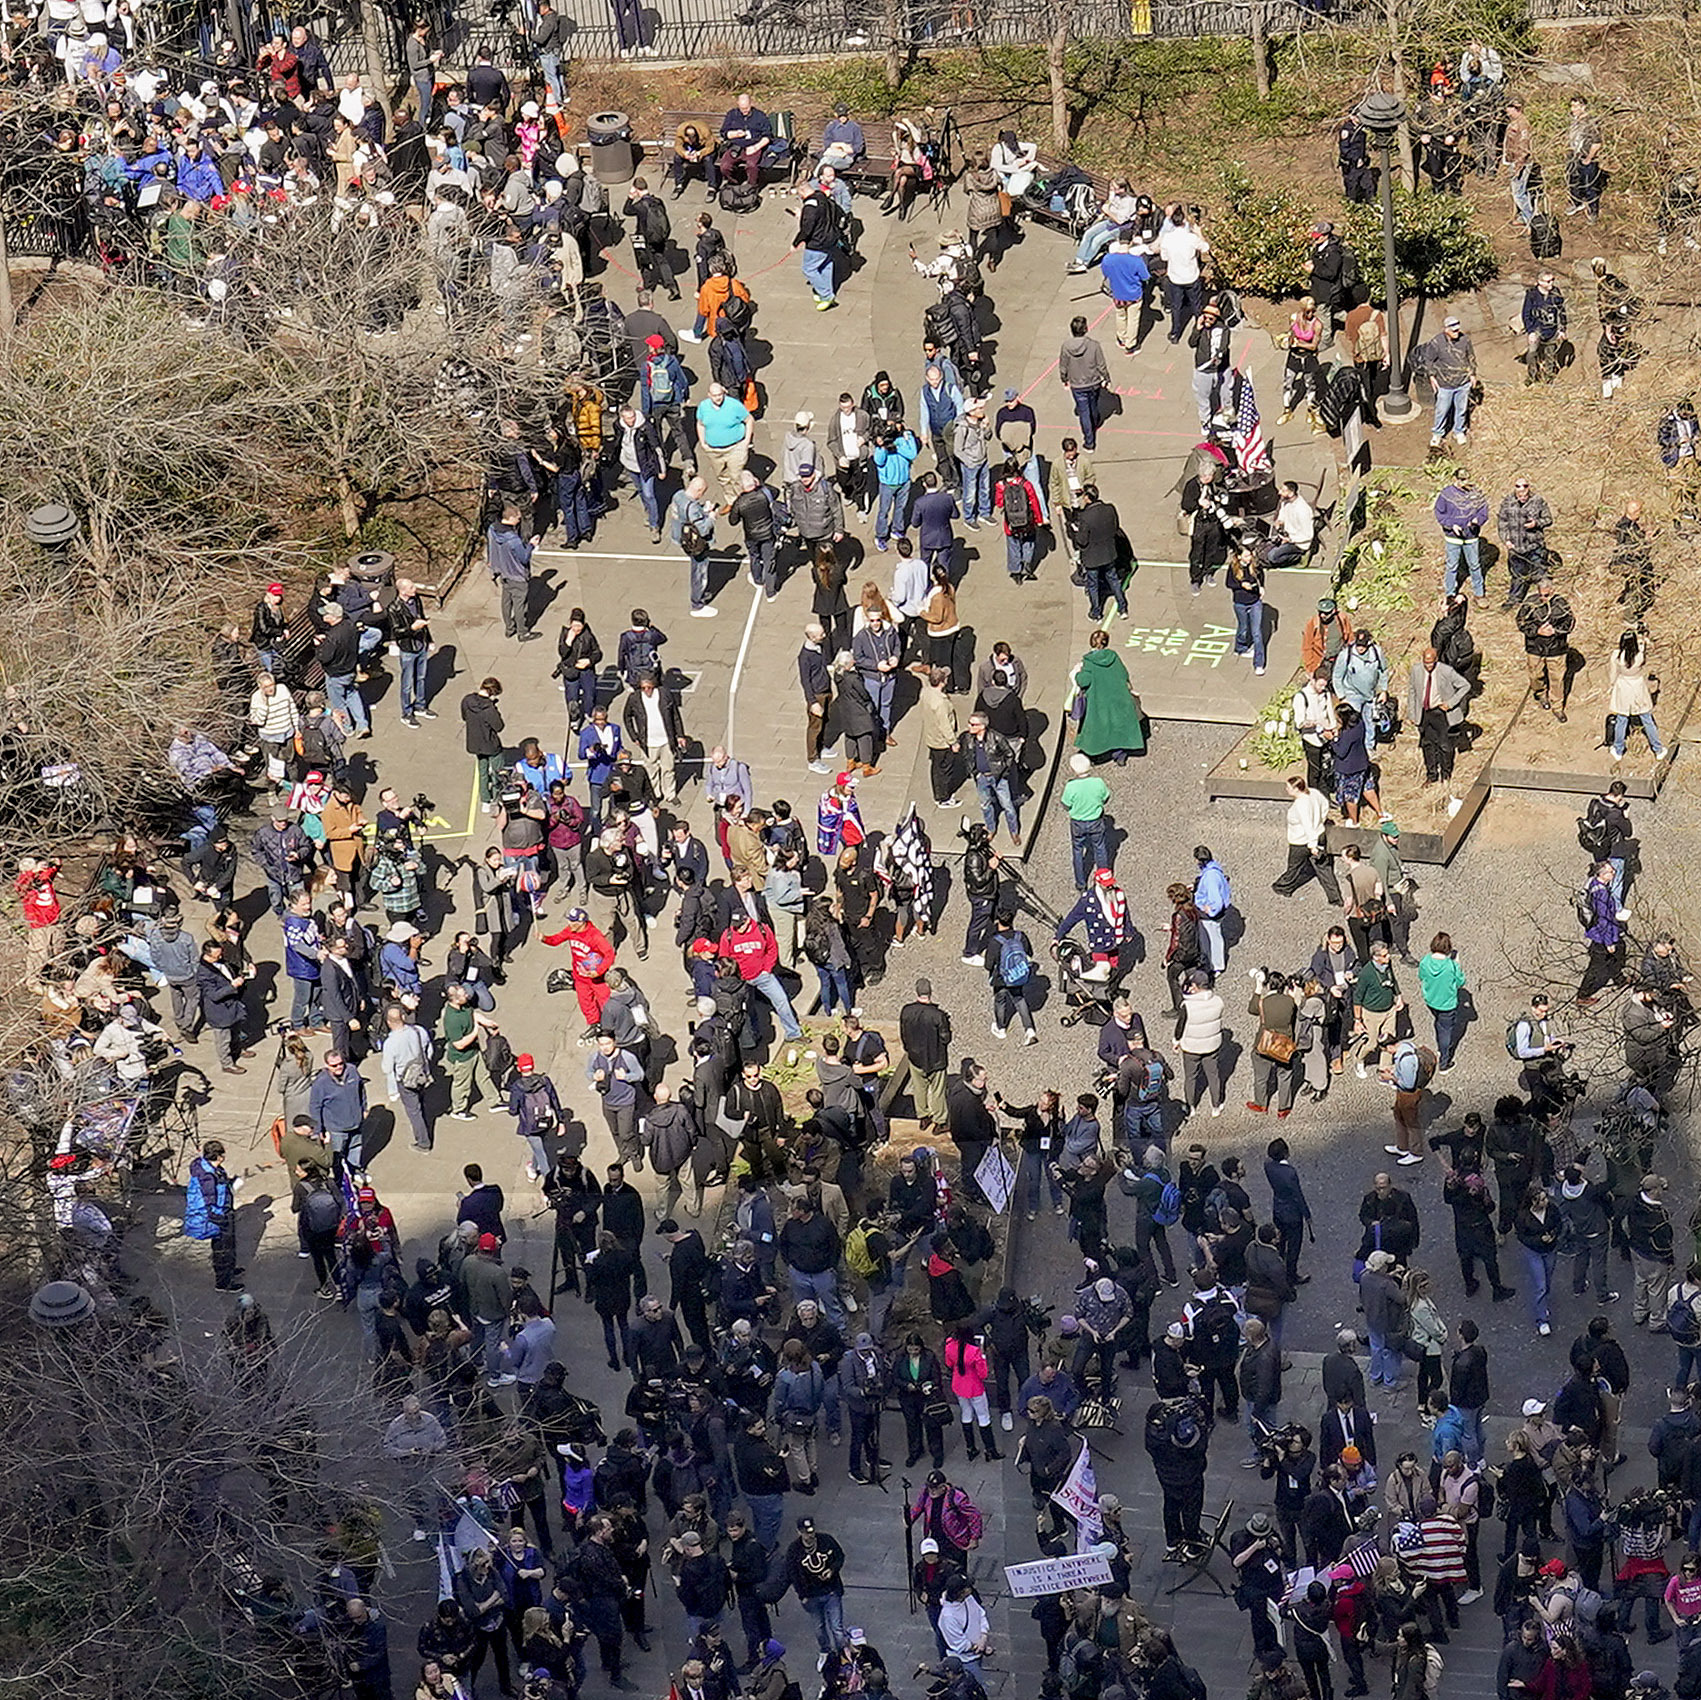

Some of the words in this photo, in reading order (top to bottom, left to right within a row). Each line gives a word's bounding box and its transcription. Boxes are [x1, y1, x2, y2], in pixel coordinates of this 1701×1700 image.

[1184, 623, 1236, 668] ABC
[1060, 1487, 1103, 1523] SAVE
[1012, 1564, 1058, 1577] INJUSTICE
[1060, 1556, 1103, 1570] ANYWHERE
[1033, 1575, 1043, 1583] IS
[1057, 1568, 1087, 1580] THREAT
[1014, 1587, 1025, 1595] TO
[1028, 1582, 1062, 1594] JUSTICE
[1063, 1573, 1112, 1589] EVERYWHERE
